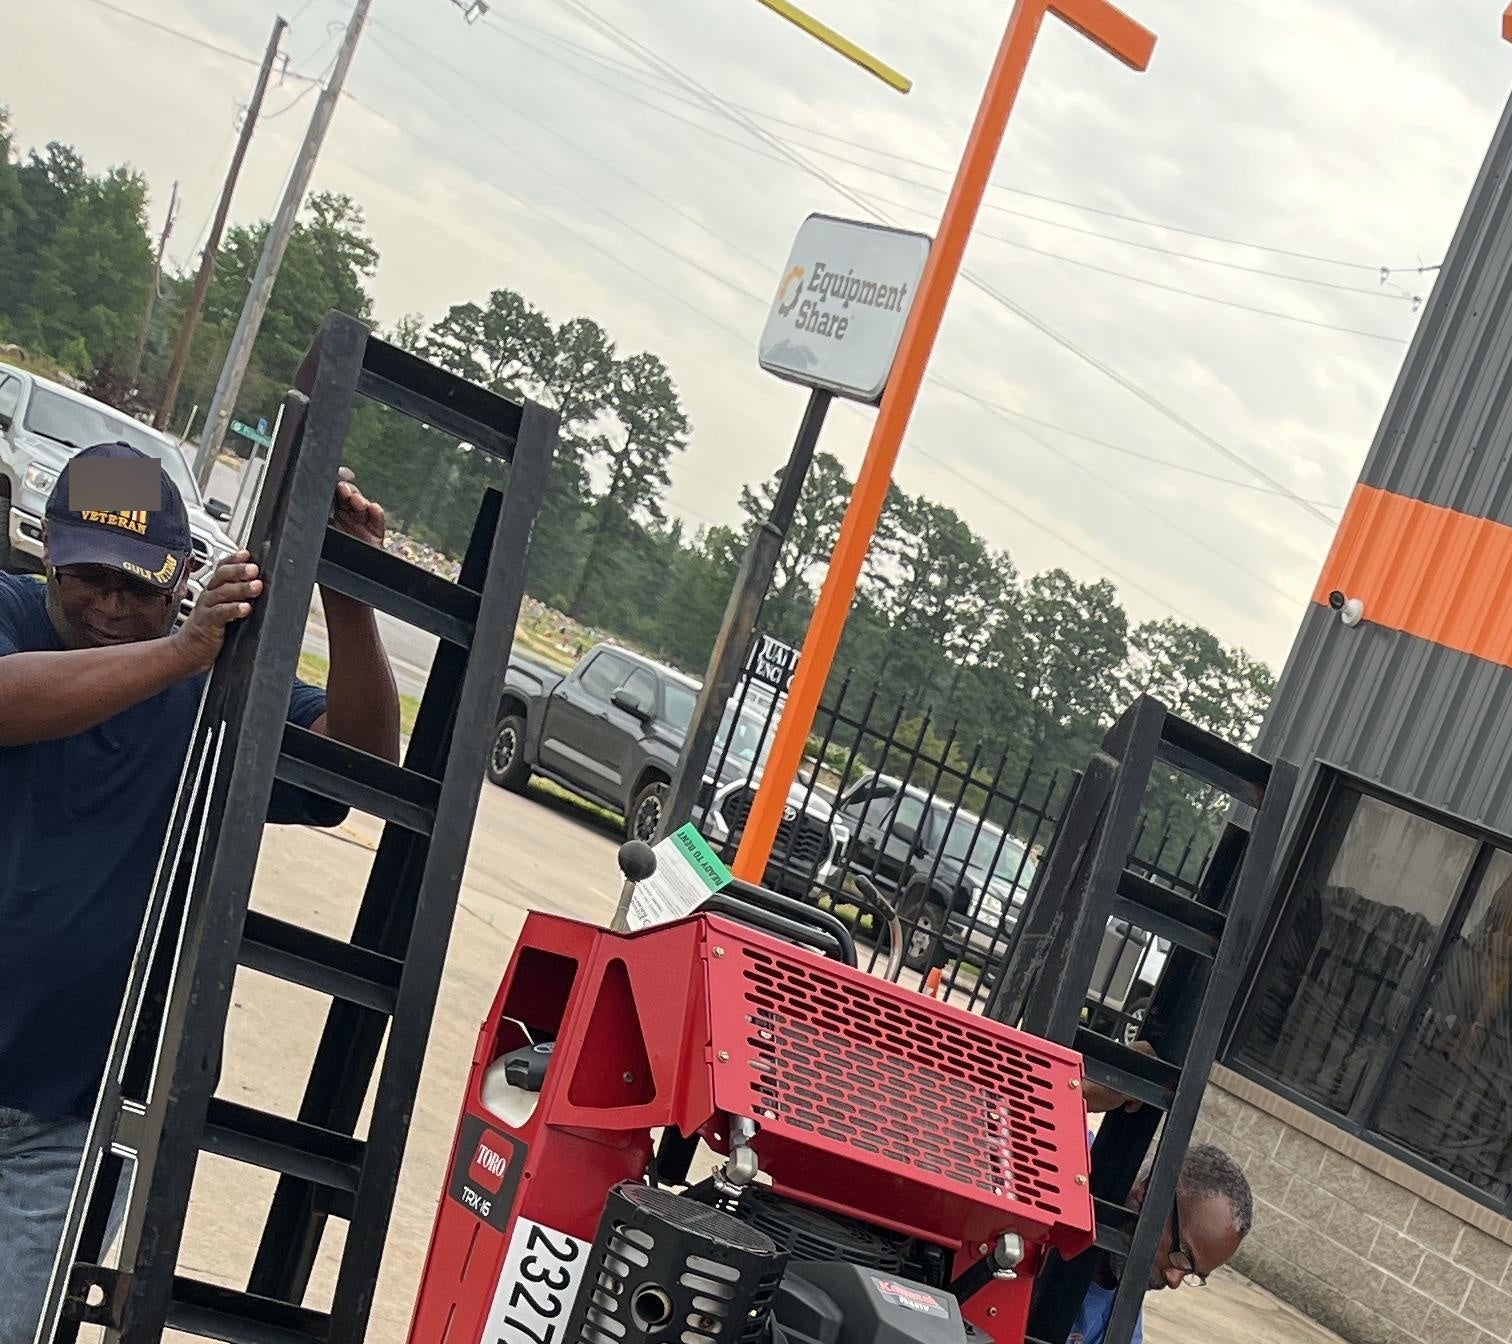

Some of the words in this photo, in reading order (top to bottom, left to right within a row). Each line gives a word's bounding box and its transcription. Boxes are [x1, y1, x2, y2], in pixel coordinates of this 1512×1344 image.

[807, 262, 908, 313] Equipment
[795, 300, 849, 340] Share
[81, 510, 148, 535] VETERAN
[677, 831, 695, 853] RENT
[692, 850, 703, 861] TO
[700, 858, 723, 886] READY
[476, 1143, 508, 1180] TORO
